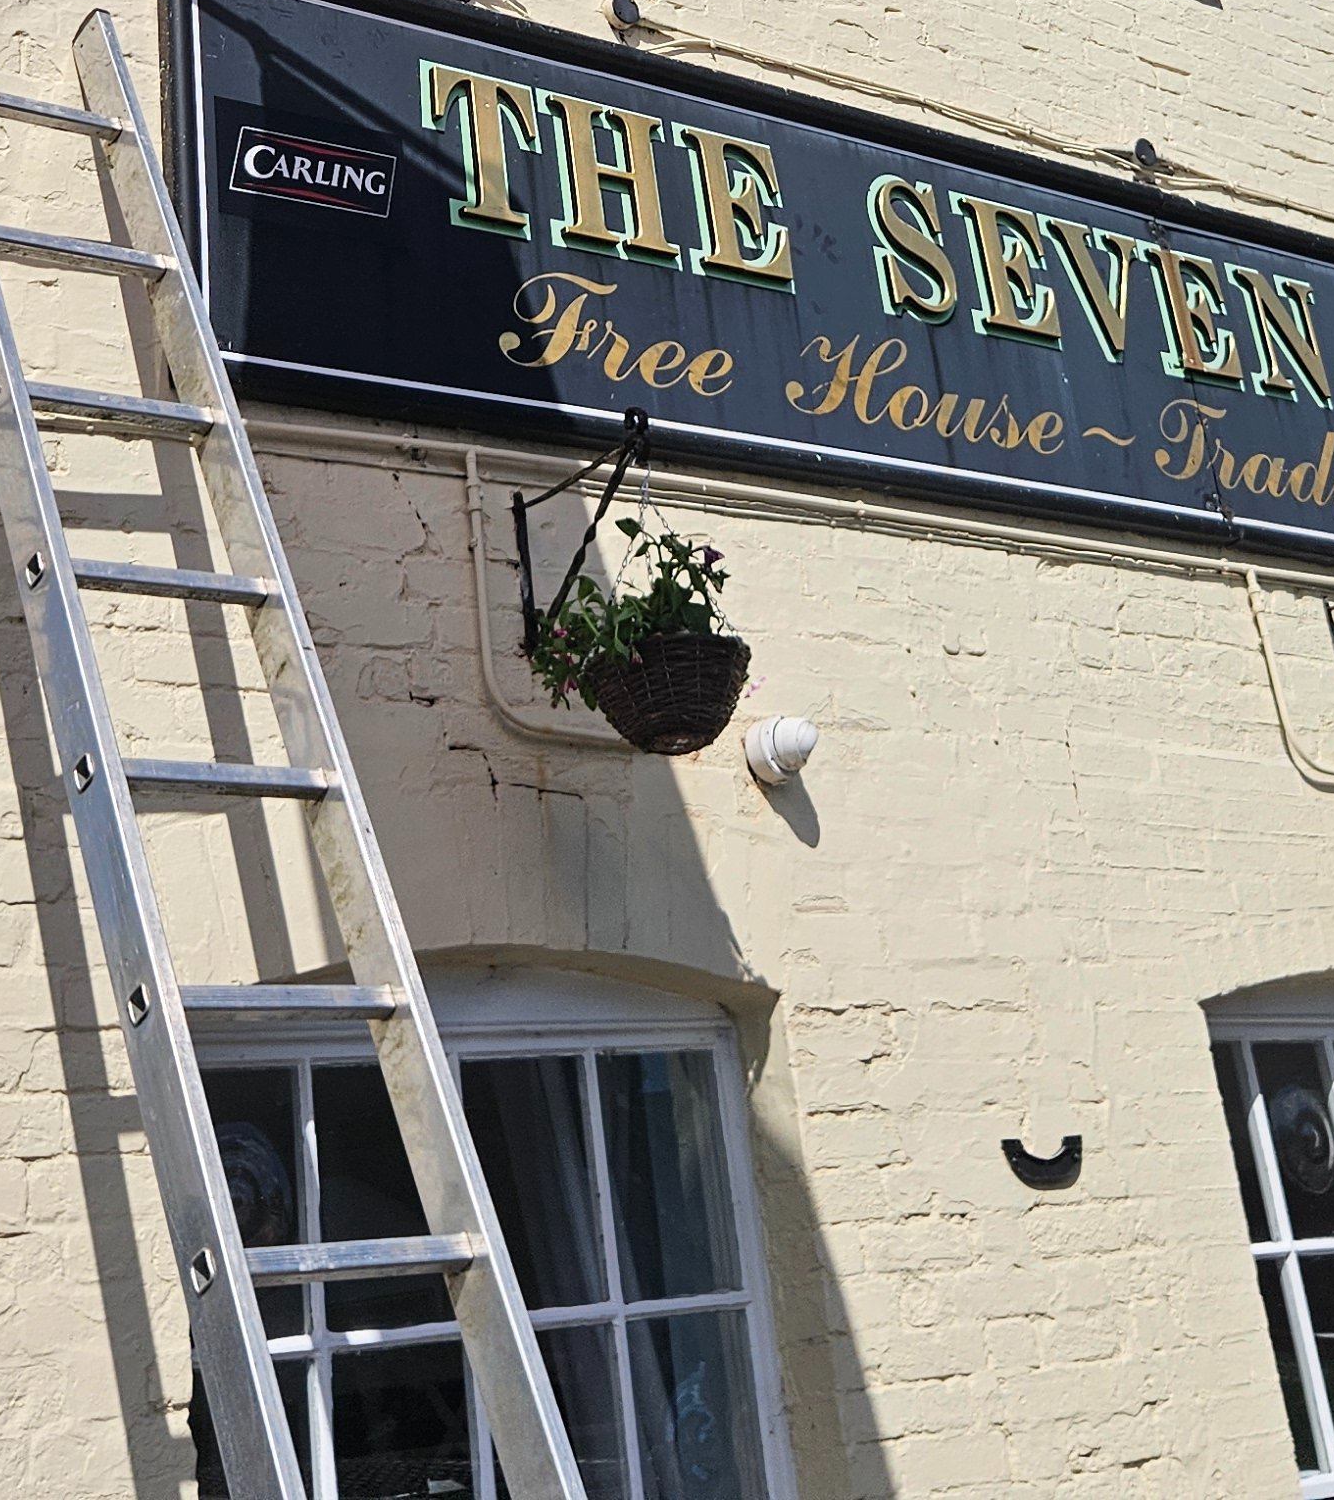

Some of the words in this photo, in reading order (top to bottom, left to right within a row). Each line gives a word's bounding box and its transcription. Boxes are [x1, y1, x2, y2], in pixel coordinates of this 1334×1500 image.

[244, 144, 386, 195] CARLING
[419, 59, 796, 294] THE
[866, 173, 1333, 409] SEVEN
[498, 272, 734, 396] Free
[785, 334, 1064, 455] House
